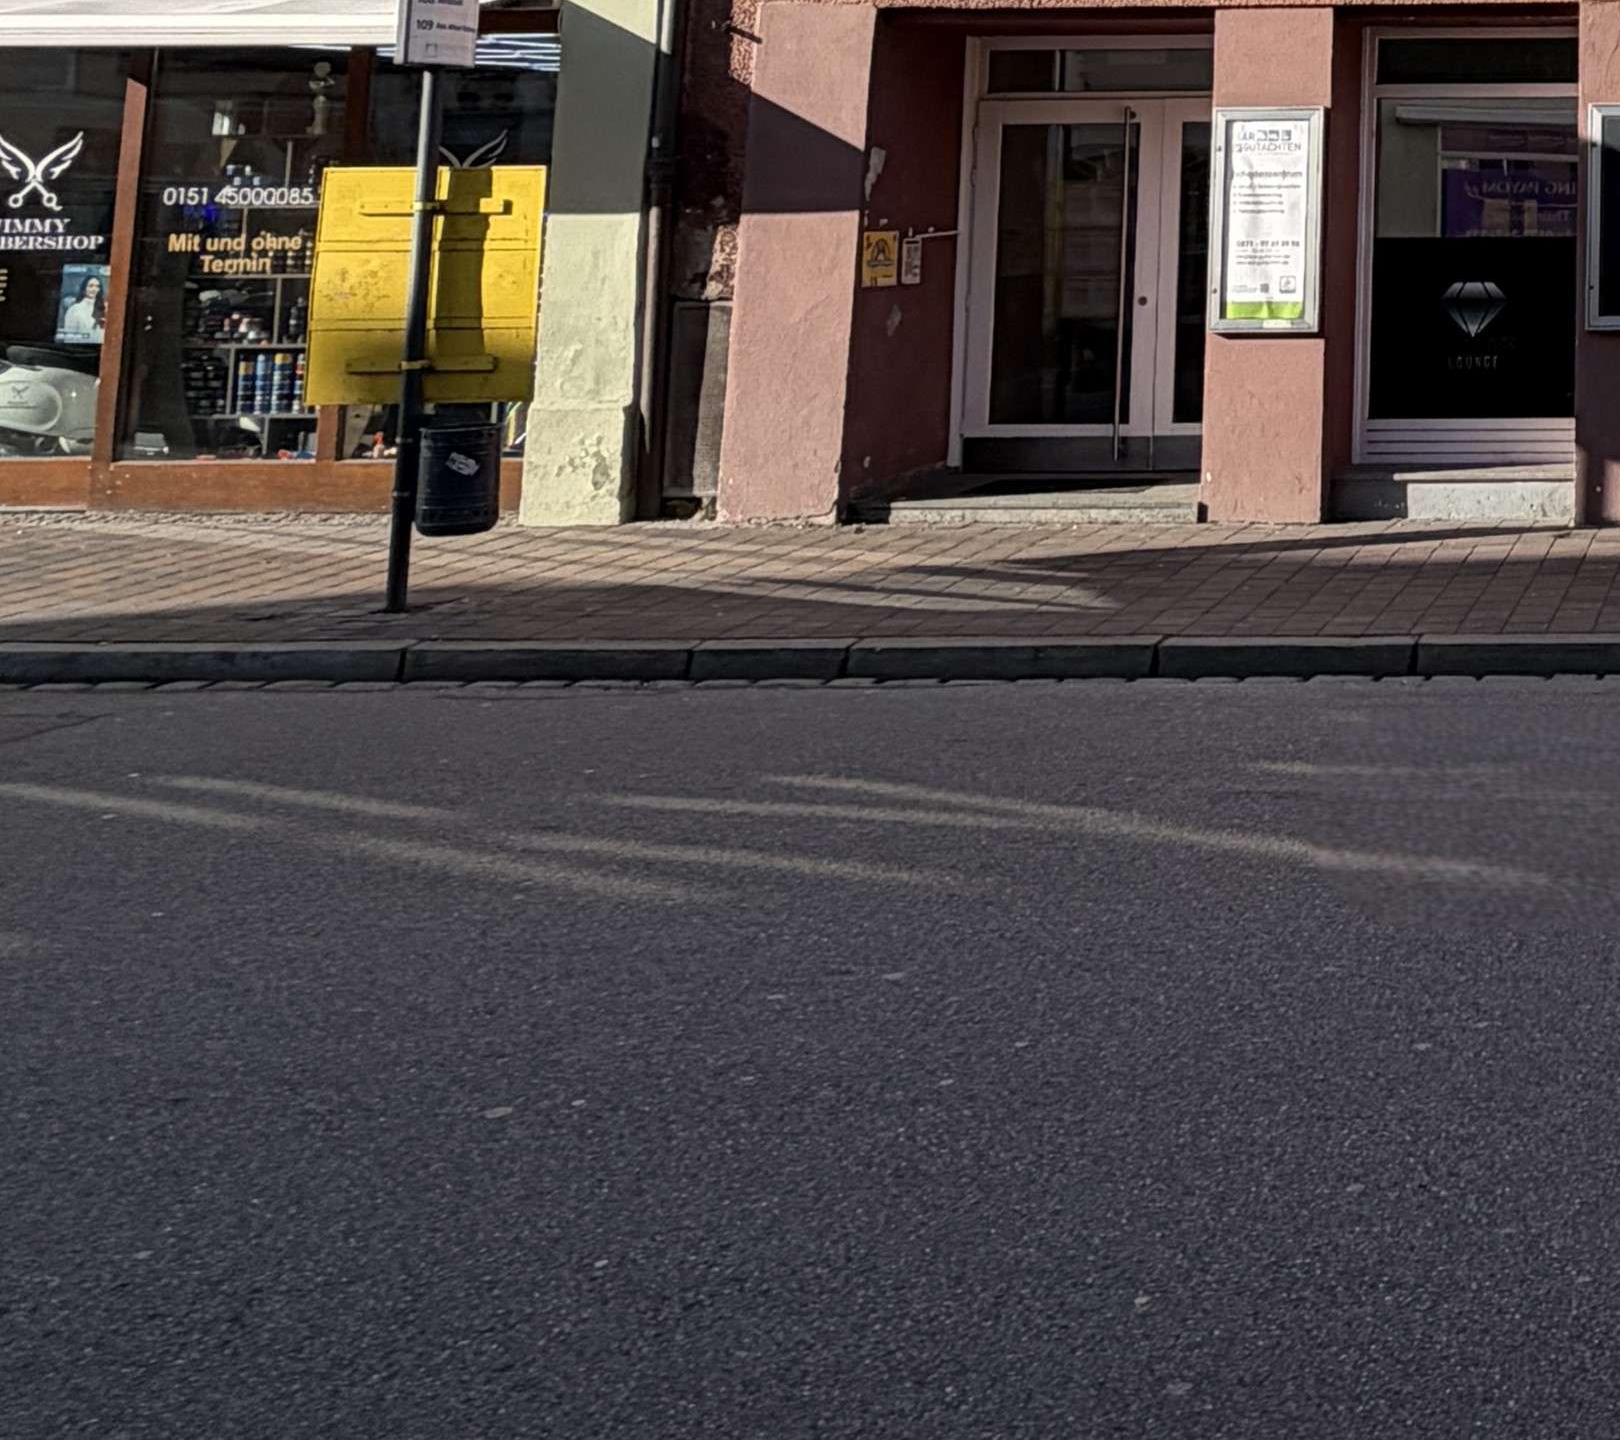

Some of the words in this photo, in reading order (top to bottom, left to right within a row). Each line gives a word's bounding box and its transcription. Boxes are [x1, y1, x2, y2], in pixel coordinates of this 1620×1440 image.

[416, 19, 434, 31] 109
[163, 187, 208, 206] 0151
[214, 186, 314, 206] 45000085
[0, 218, 70, 234] IMMY
[168, 233, 201, 252] Mit
[206, 234, 246, 252] und
[252, 232, 303, 251] ohne
[199, 255, 273, 274] Termin
